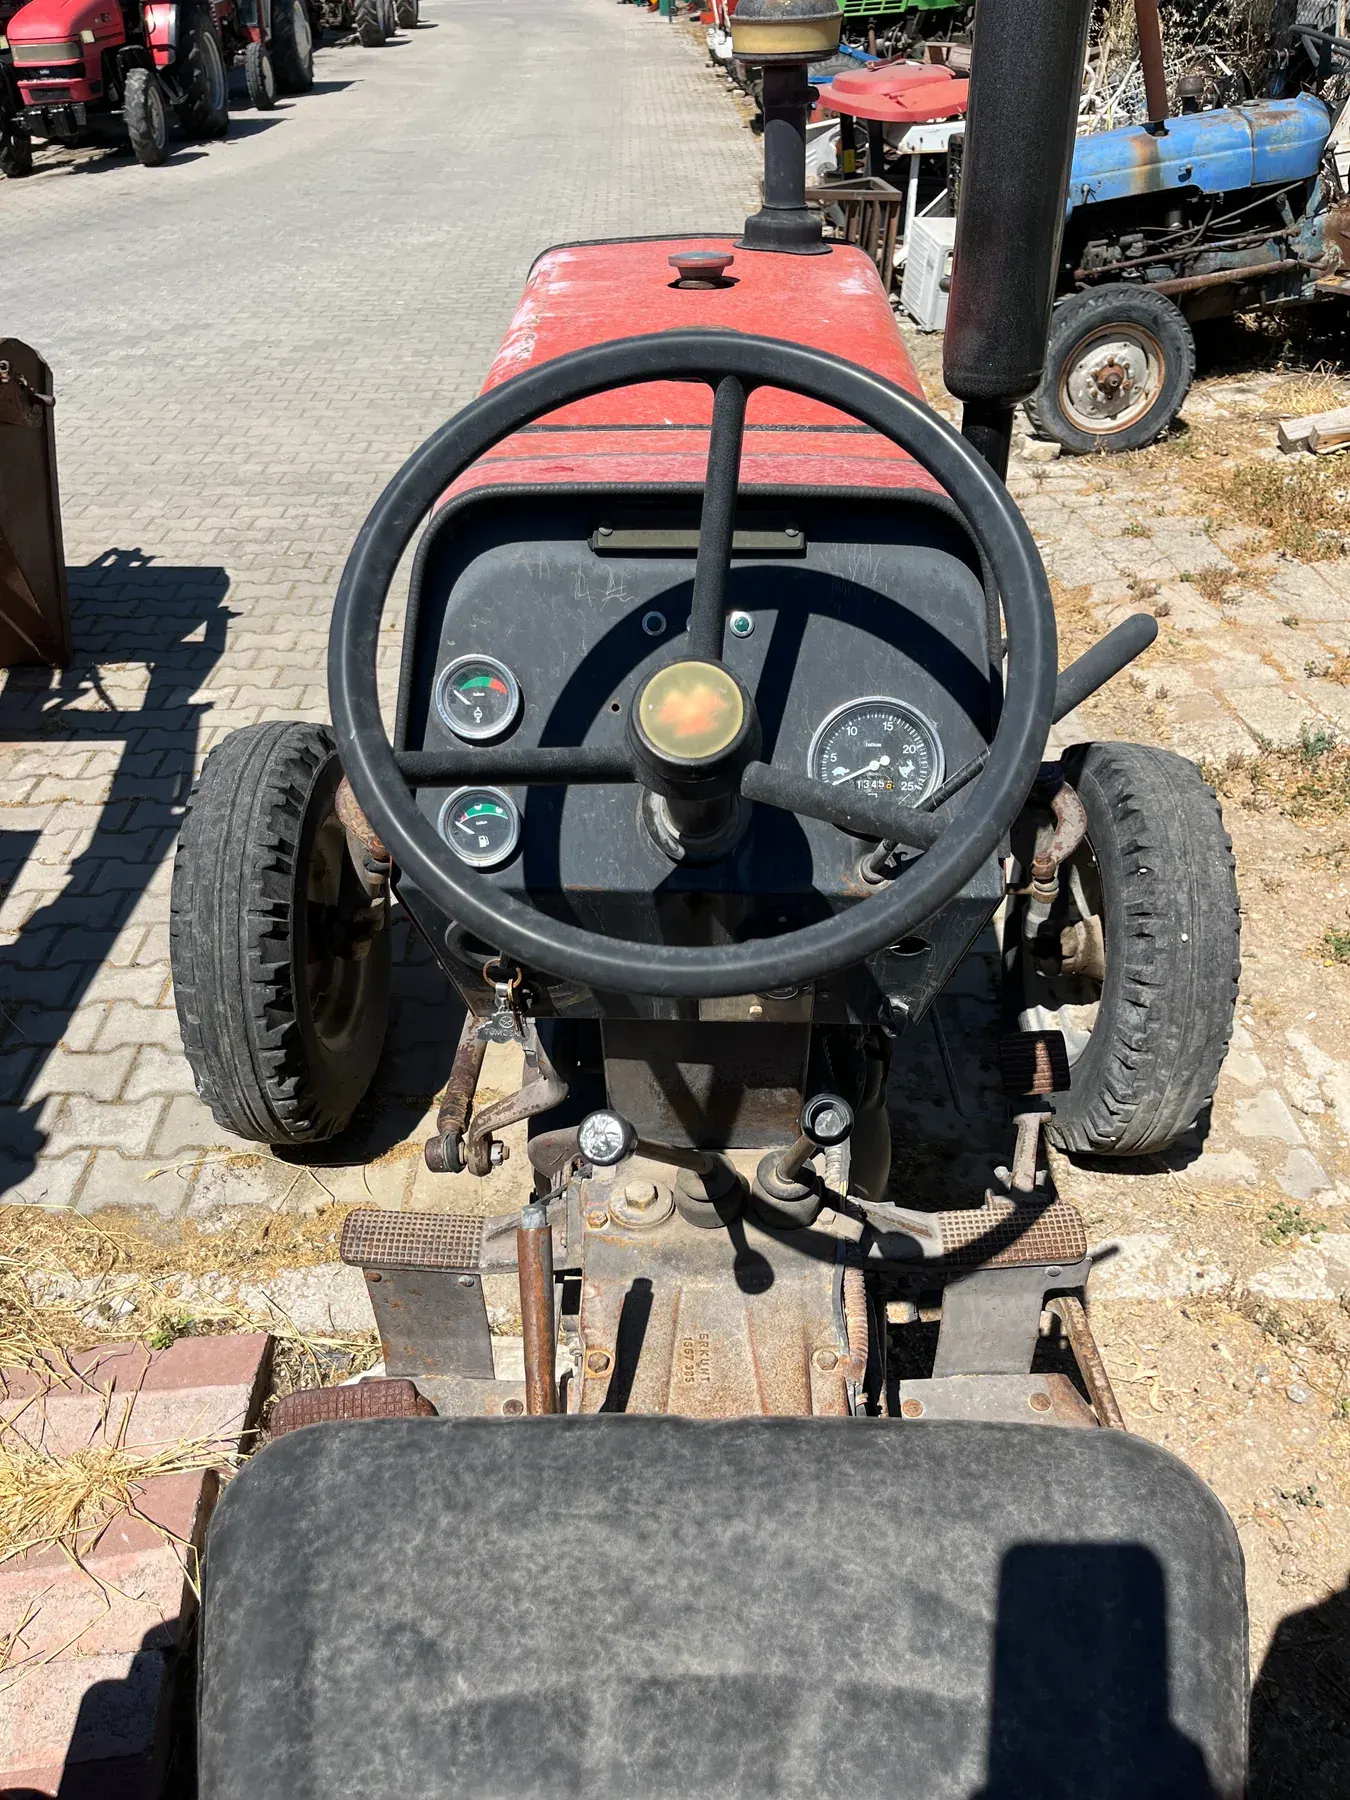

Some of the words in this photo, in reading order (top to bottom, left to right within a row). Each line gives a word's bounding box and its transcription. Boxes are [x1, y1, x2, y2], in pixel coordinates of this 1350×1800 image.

[846, 726, 858, 736] 10
[882, 721, 894, 731] 15
[902, 744, 917, 754] 20
[830, 753, 837, 762] 5
[900, 781, 914, 791] 25
[699, 1333, 710, 1382] ERKUNT
